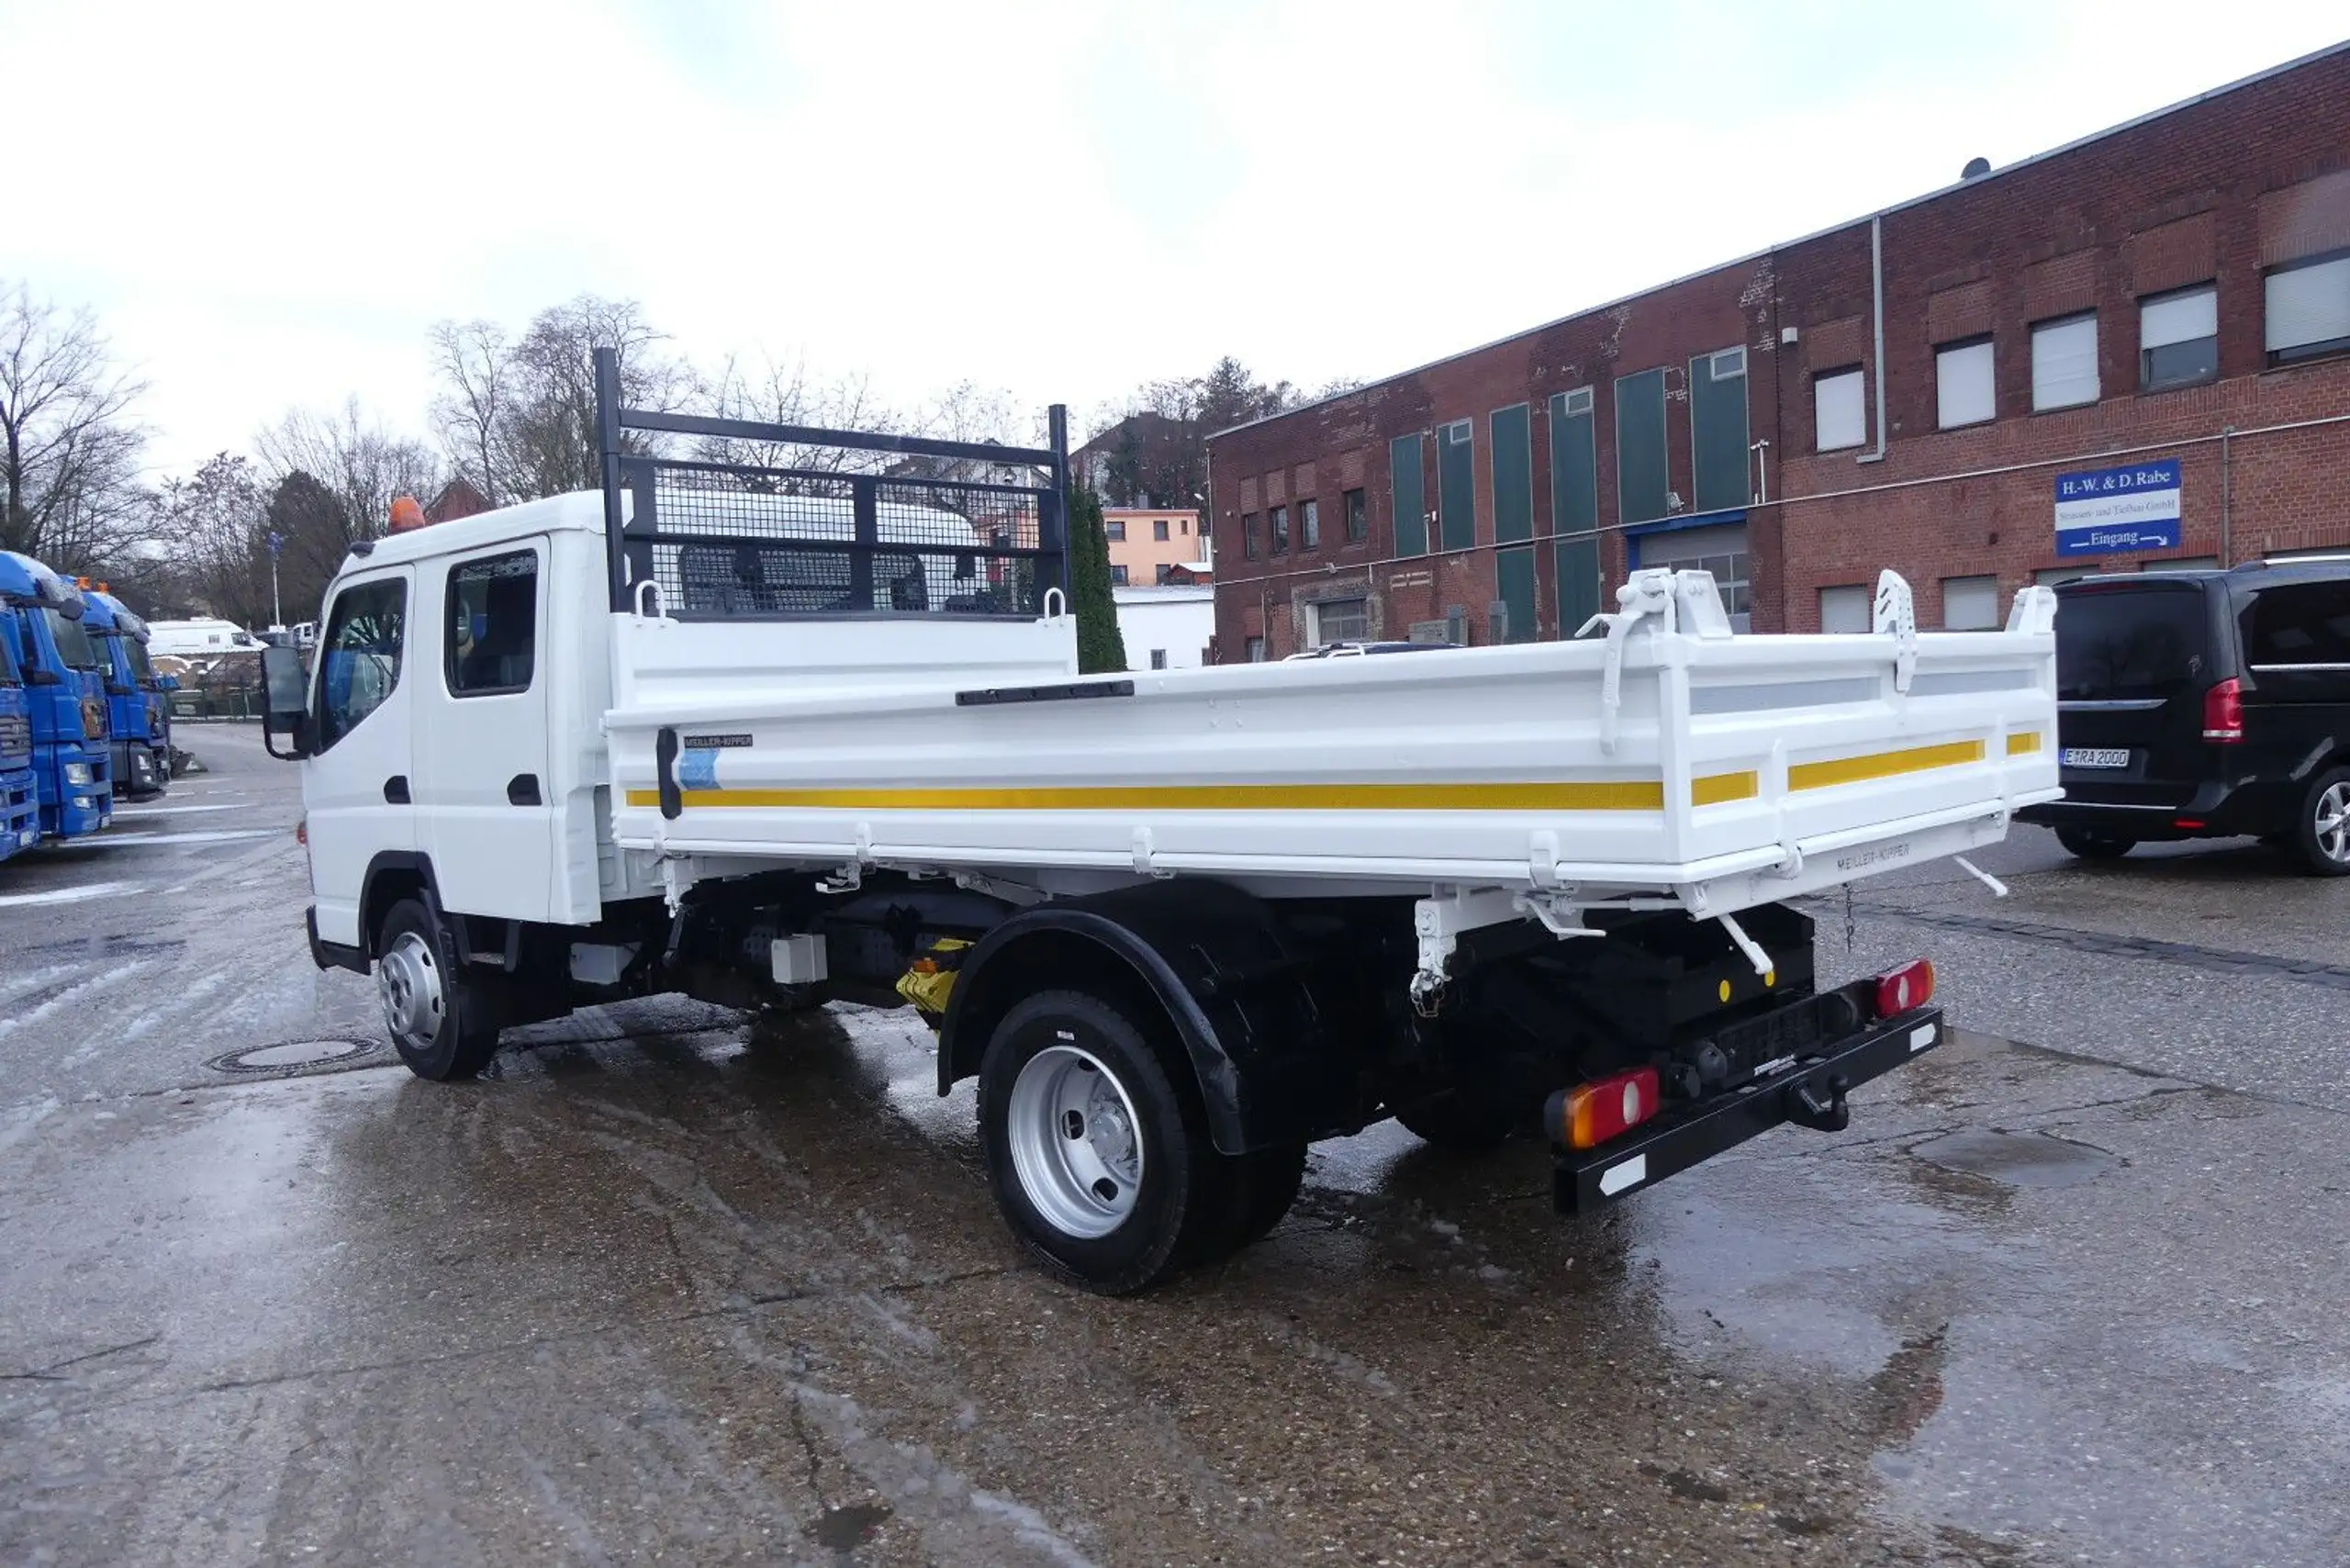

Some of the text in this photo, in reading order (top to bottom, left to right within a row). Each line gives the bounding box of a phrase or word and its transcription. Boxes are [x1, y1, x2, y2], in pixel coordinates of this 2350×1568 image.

[2103, 476, 2115, 490] &
[2119, 474, 2134, 487] D.
[2136, 470, 2171, 486] Rabe
[2090, 531, 2139, 547] Eingang
[2065, 750, 2127, 765] E RA 2000
[1837, 843, 1910, 872] MELLER-KIPPER
